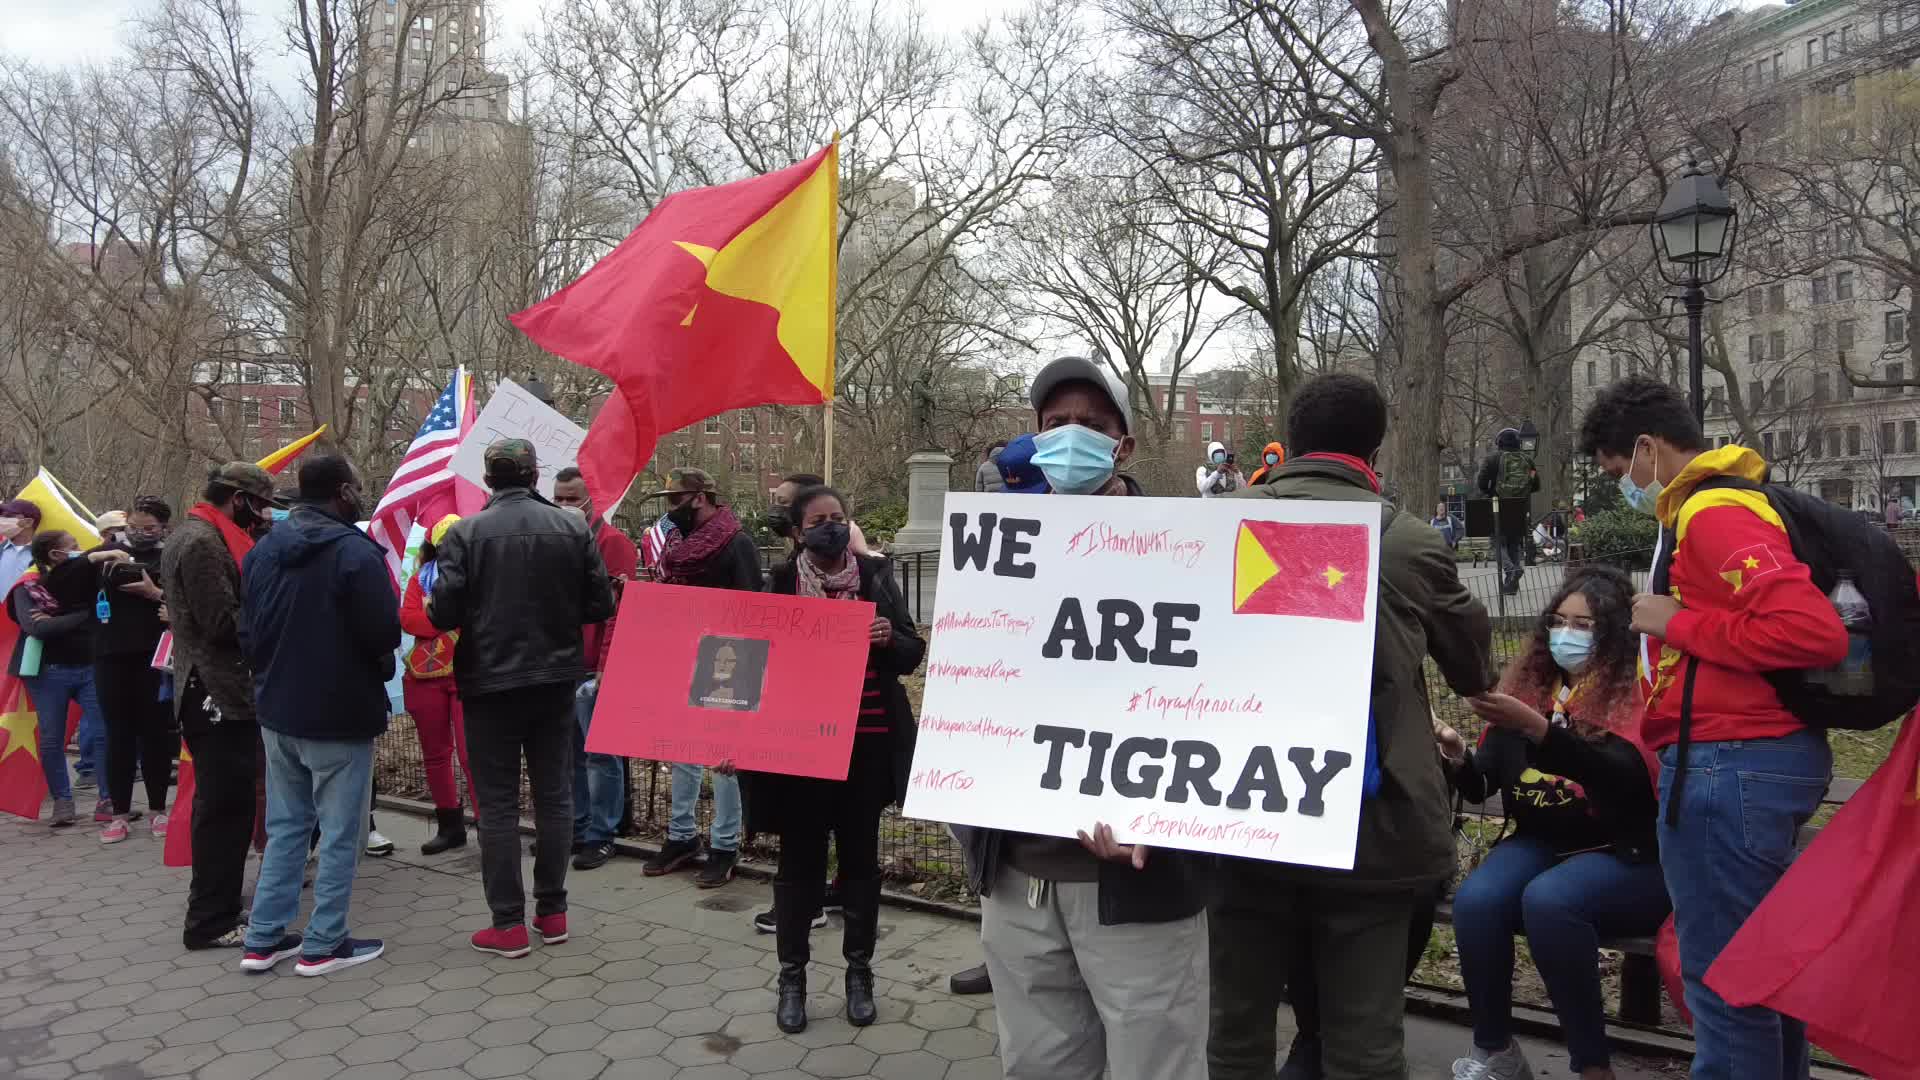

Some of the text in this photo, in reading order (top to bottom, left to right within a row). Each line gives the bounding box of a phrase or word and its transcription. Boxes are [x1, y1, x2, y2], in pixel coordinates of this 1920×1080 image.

[950, 512, 1041, 579] WE
[1041, 597, 1200, 668] ARE
[1126, 683, 1264, 719] #TigrayGenocide
[1033, 724, 1352, 817] TIGRAY
